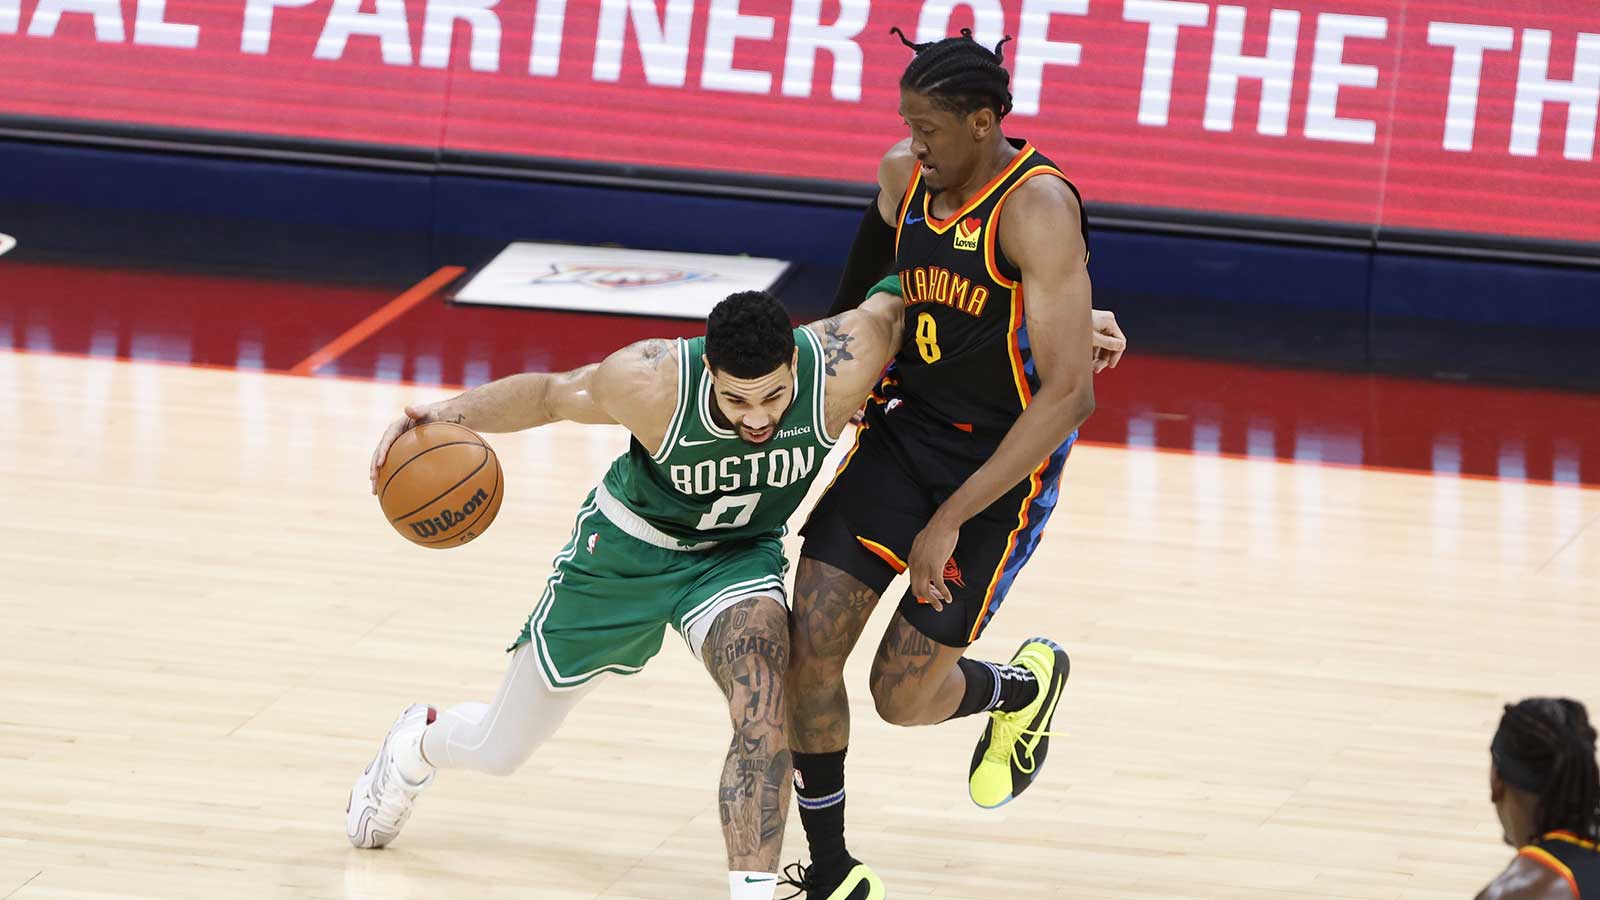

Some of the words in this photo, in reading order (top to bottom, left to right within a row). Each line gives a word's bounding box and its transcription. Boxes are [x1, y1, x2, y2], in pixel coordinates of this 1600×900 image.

[1123, 0, 1388, 144] THE
[1427, 20, 1600, 161] TH
[915, 312, 942, 364] 8
[774, 425, 812, 440] Amica
[670, 446, 815, 495] BOSTON
[408, 488, 489, 538] Wilson
[696, 492, 762, 531] 0
